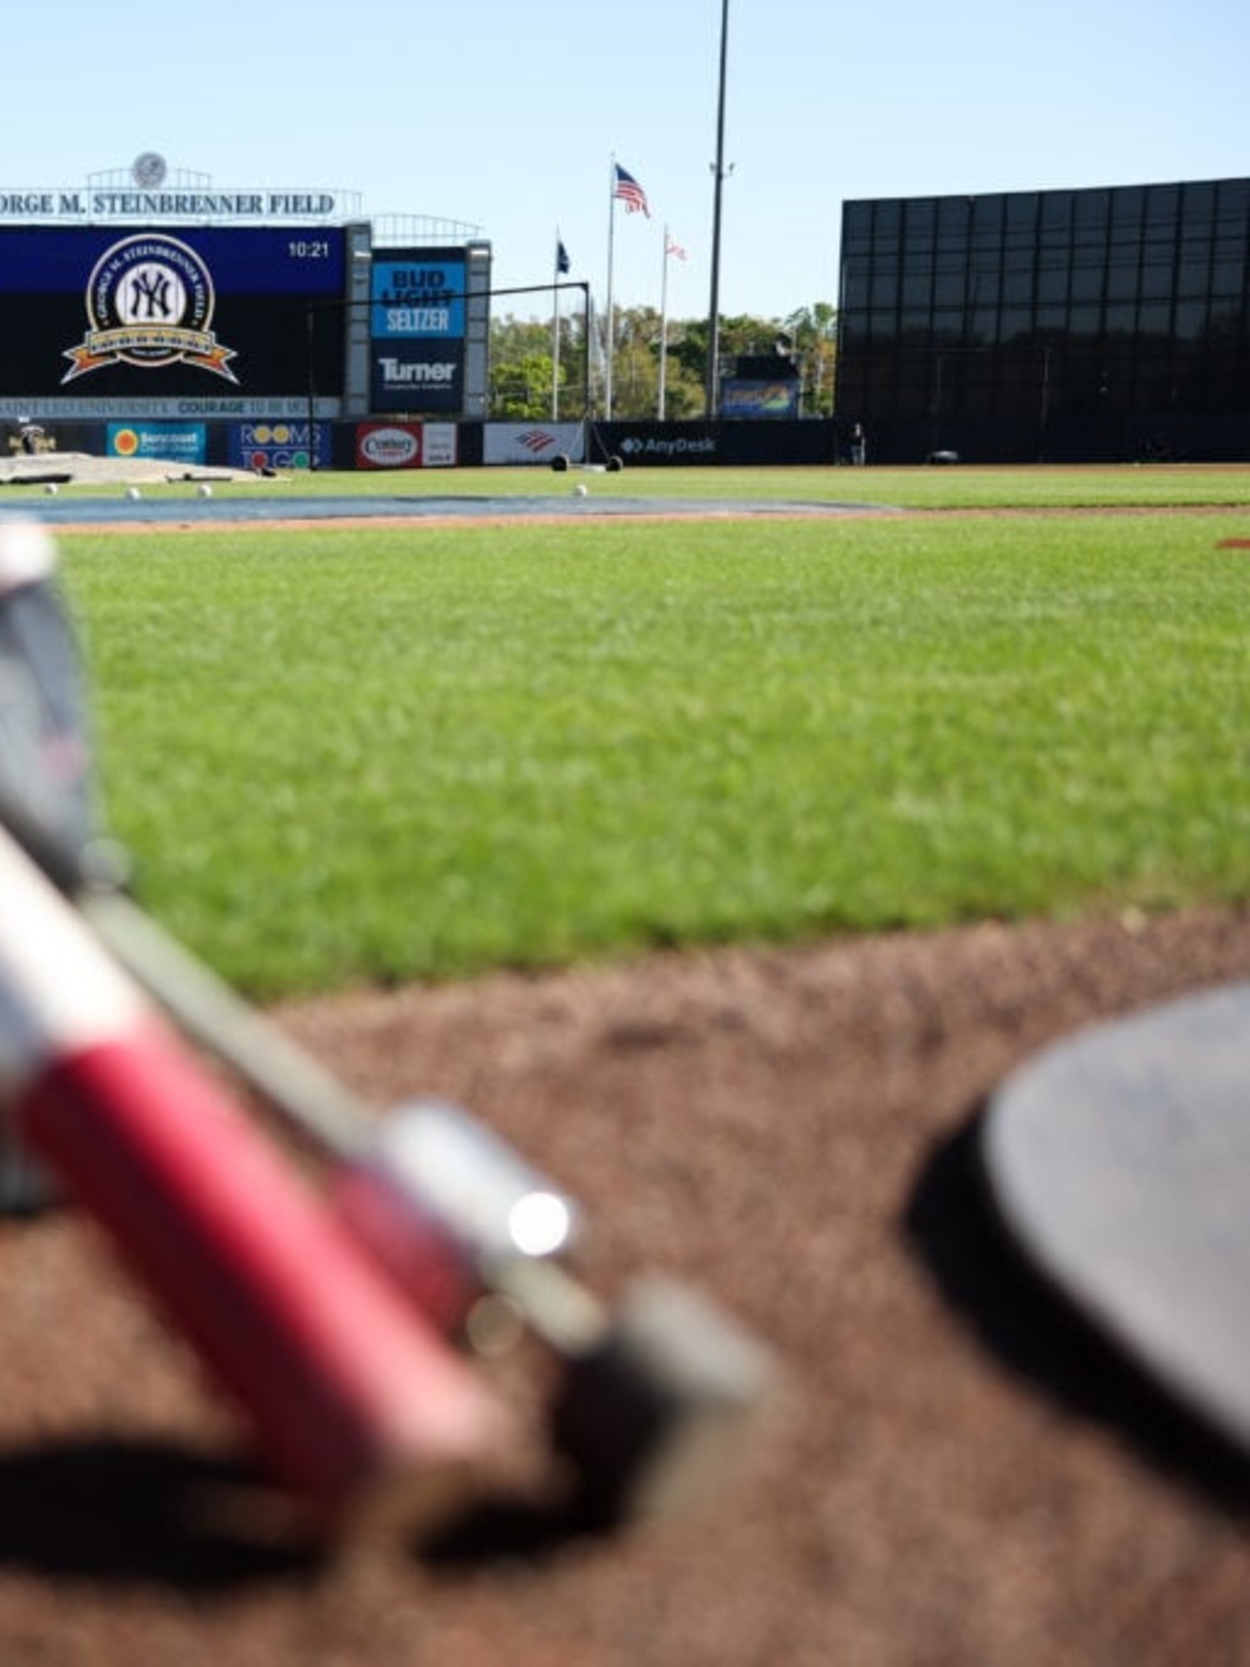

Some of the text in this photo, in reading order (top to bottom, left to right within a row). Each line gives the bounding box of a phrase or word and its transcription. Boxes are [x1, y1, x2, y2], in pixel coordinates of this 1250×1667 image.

[58, 194, 86, 214] M.
[93, 193, 263, 214] STEINBRENNER
[269, 193, 335, 214] FIELD
[288, 242, 329, 257] 10:21
[392, 270, 446, 288] BUD
[131, 271, 171, 318] NY
[381, 289, 456, 308] LIGHT
[387, 308, 449, 331] SELTZER
[378, 358, 457, 382] Turner
[177, 402, 245, 414] COURAGE
[141, 431, 198, 444] Suncoast
[241, 424, 322, 444] ROOMS
[646, 438, 715, 454] AnyDesk
[242, 451, 310, 470] TO GO
